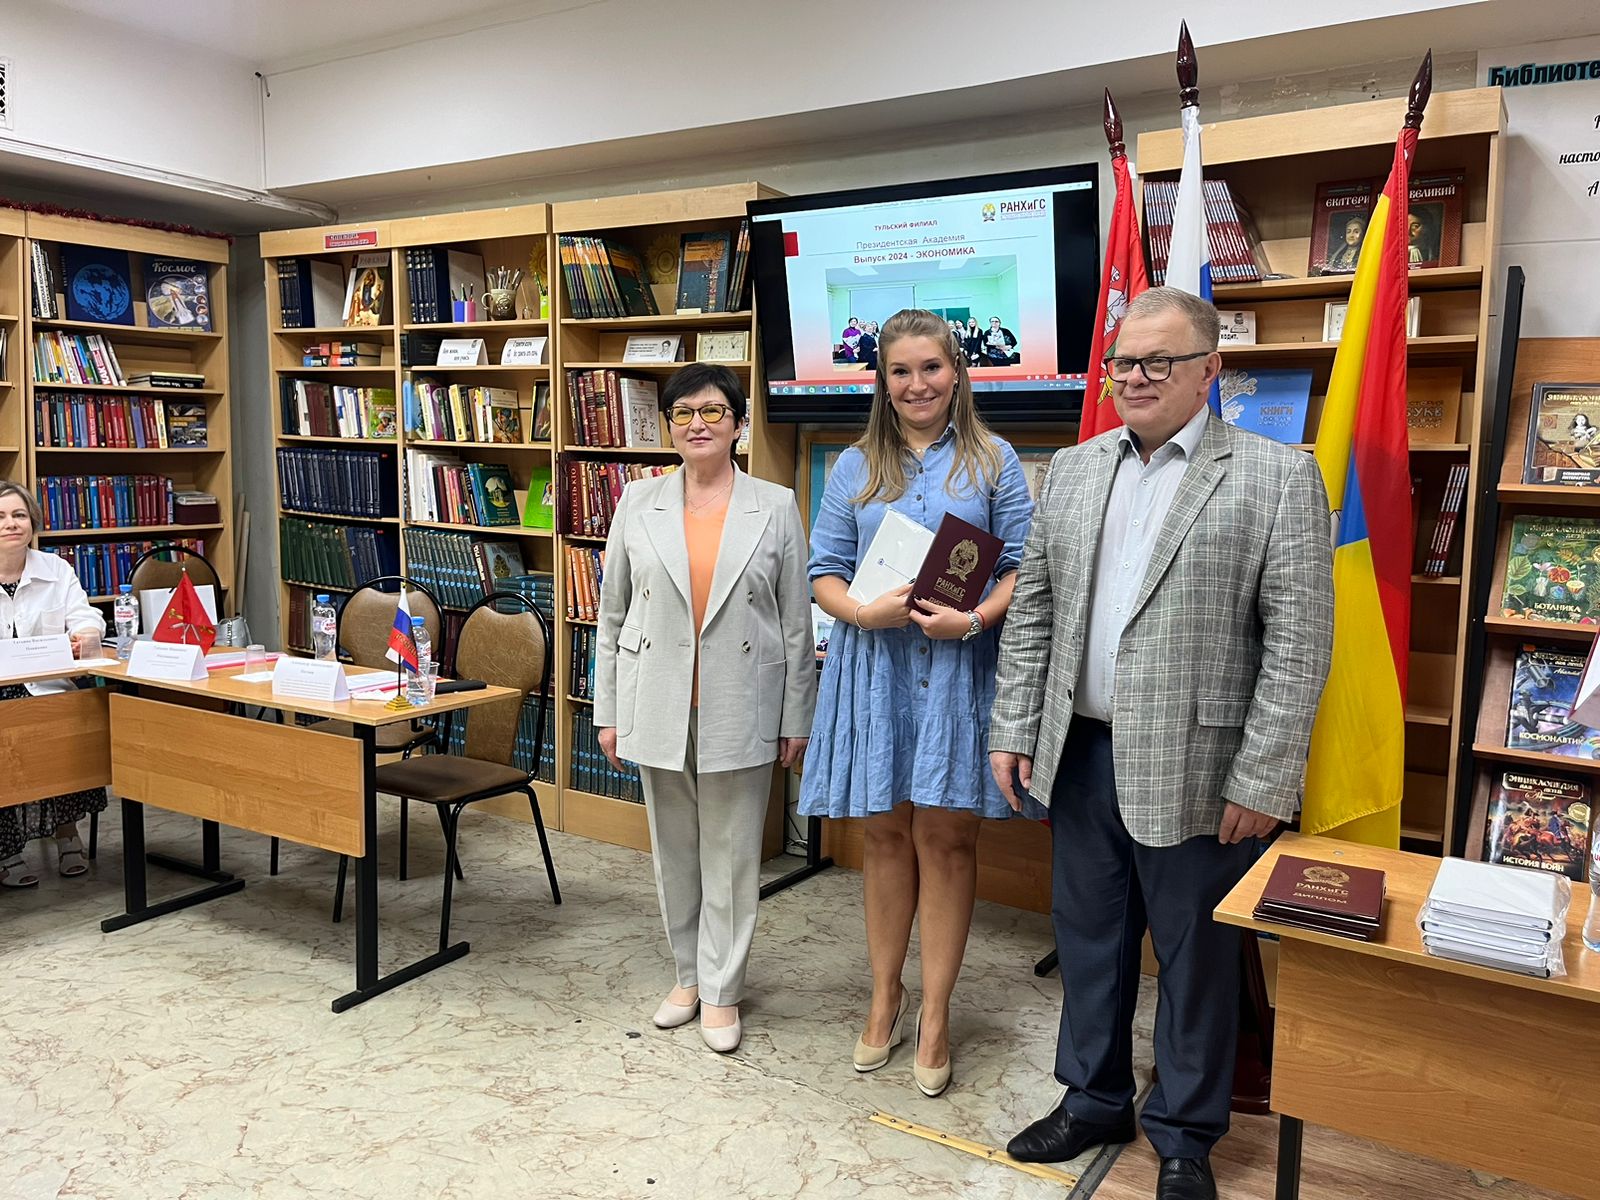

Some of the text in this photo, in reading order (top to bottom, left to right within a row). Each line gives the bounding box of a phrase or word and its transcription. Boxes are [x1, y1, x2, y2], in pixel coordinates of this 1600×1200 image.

[1409, 184, 1456, 199] ВЕЛИКИЙ
[1000, 198, 1046, 213] РАНХиГС
[874, 219, 938, 231] ТУЛЬСКИЙ ФИЛИАЛ
[856, 234, 966, 250] Президентская Академия
[854, 254, 887, 264] Выпуск
[888, 252, 908, 261] 2024
[916, 246, 976, 259] ЭКОНОМИКА
[152, 262, 197, 272] Космос
[936, 577, 966, 597] РАНХиГС
[1534, 602, 1581, 613] БОТАНИКА
[1502, 855, 1564, 872] ИСТОРИЯ ВОЙН
[1296, 882, 1349, 895] РАНХиГС
[1293, 891, 1347, 904] ДИПЛОМ
